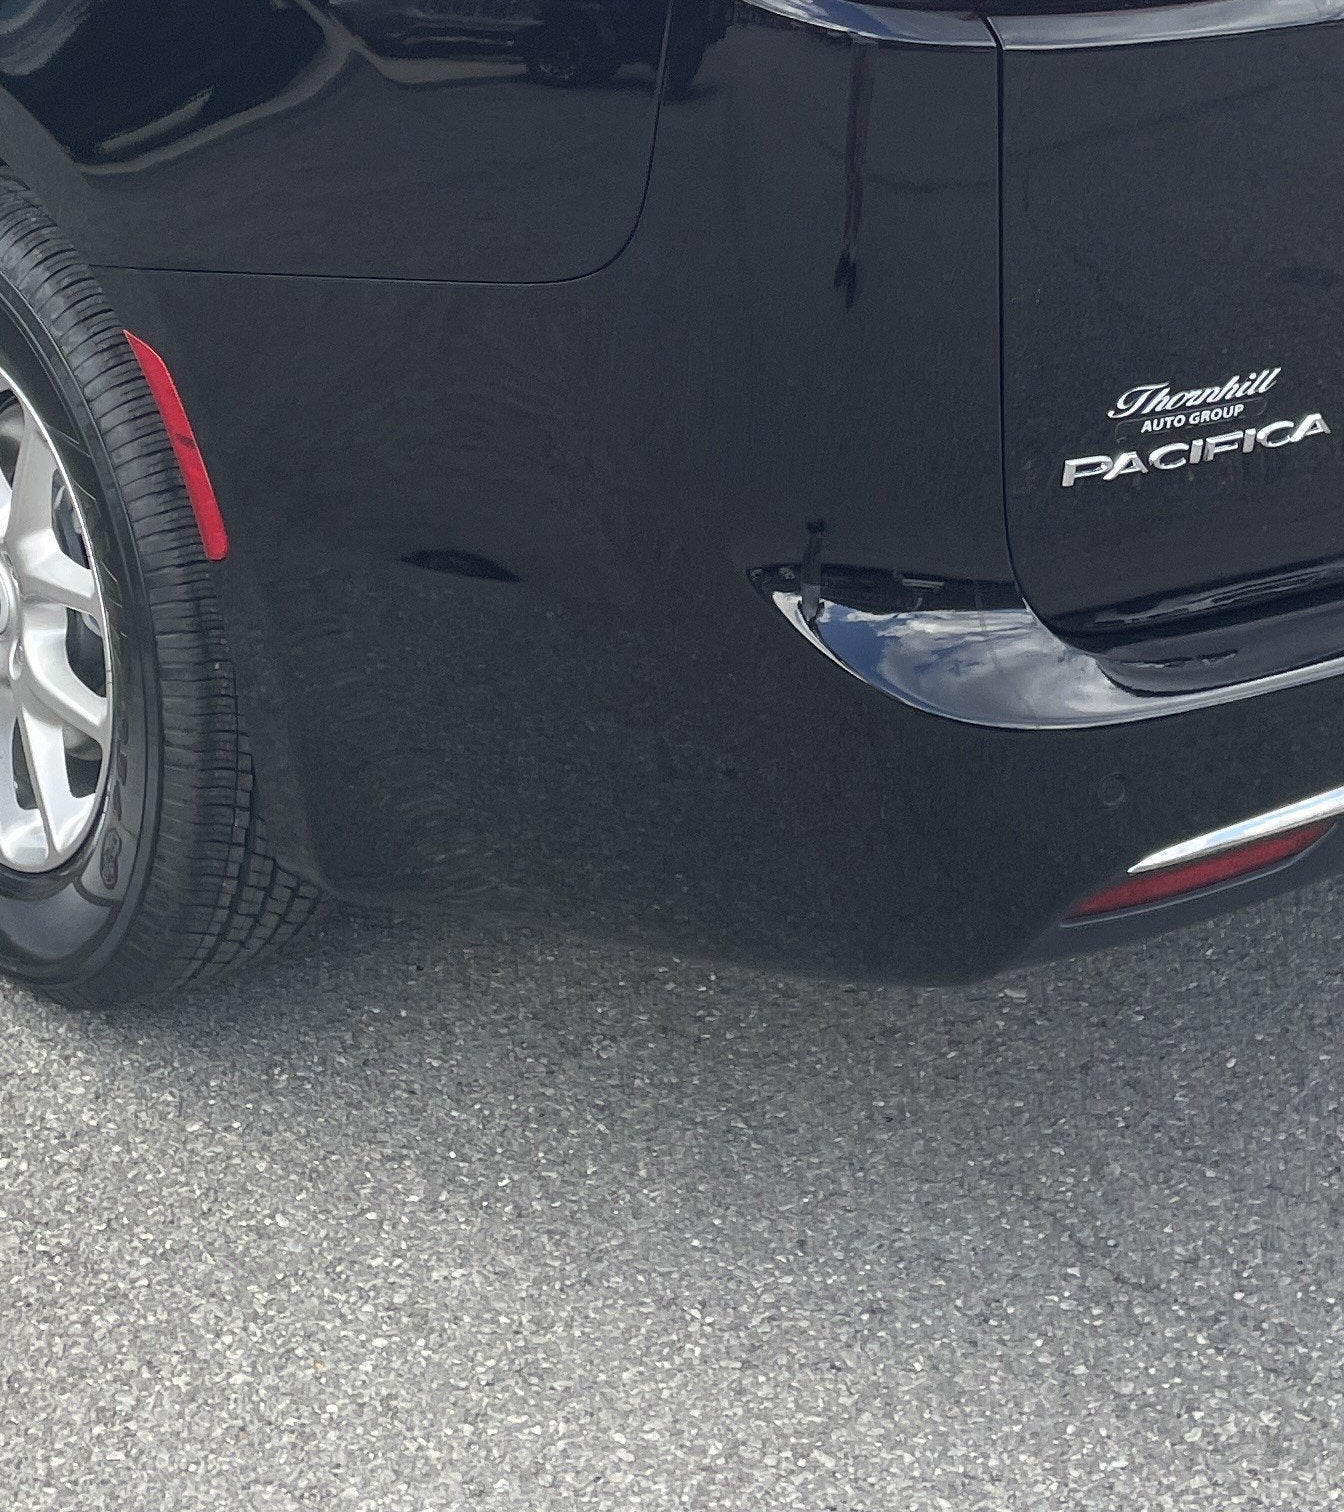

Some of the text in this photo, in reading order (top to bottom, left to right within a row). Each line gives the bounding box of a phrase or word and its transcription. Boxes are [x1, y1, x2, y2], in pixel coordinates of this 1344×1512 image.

[1107, 366, 1282, 419] Thornhill
[1140, 403, 1245, 434] AUTO GROUP
[1061, 412, 1332, 488] PACIFICA
